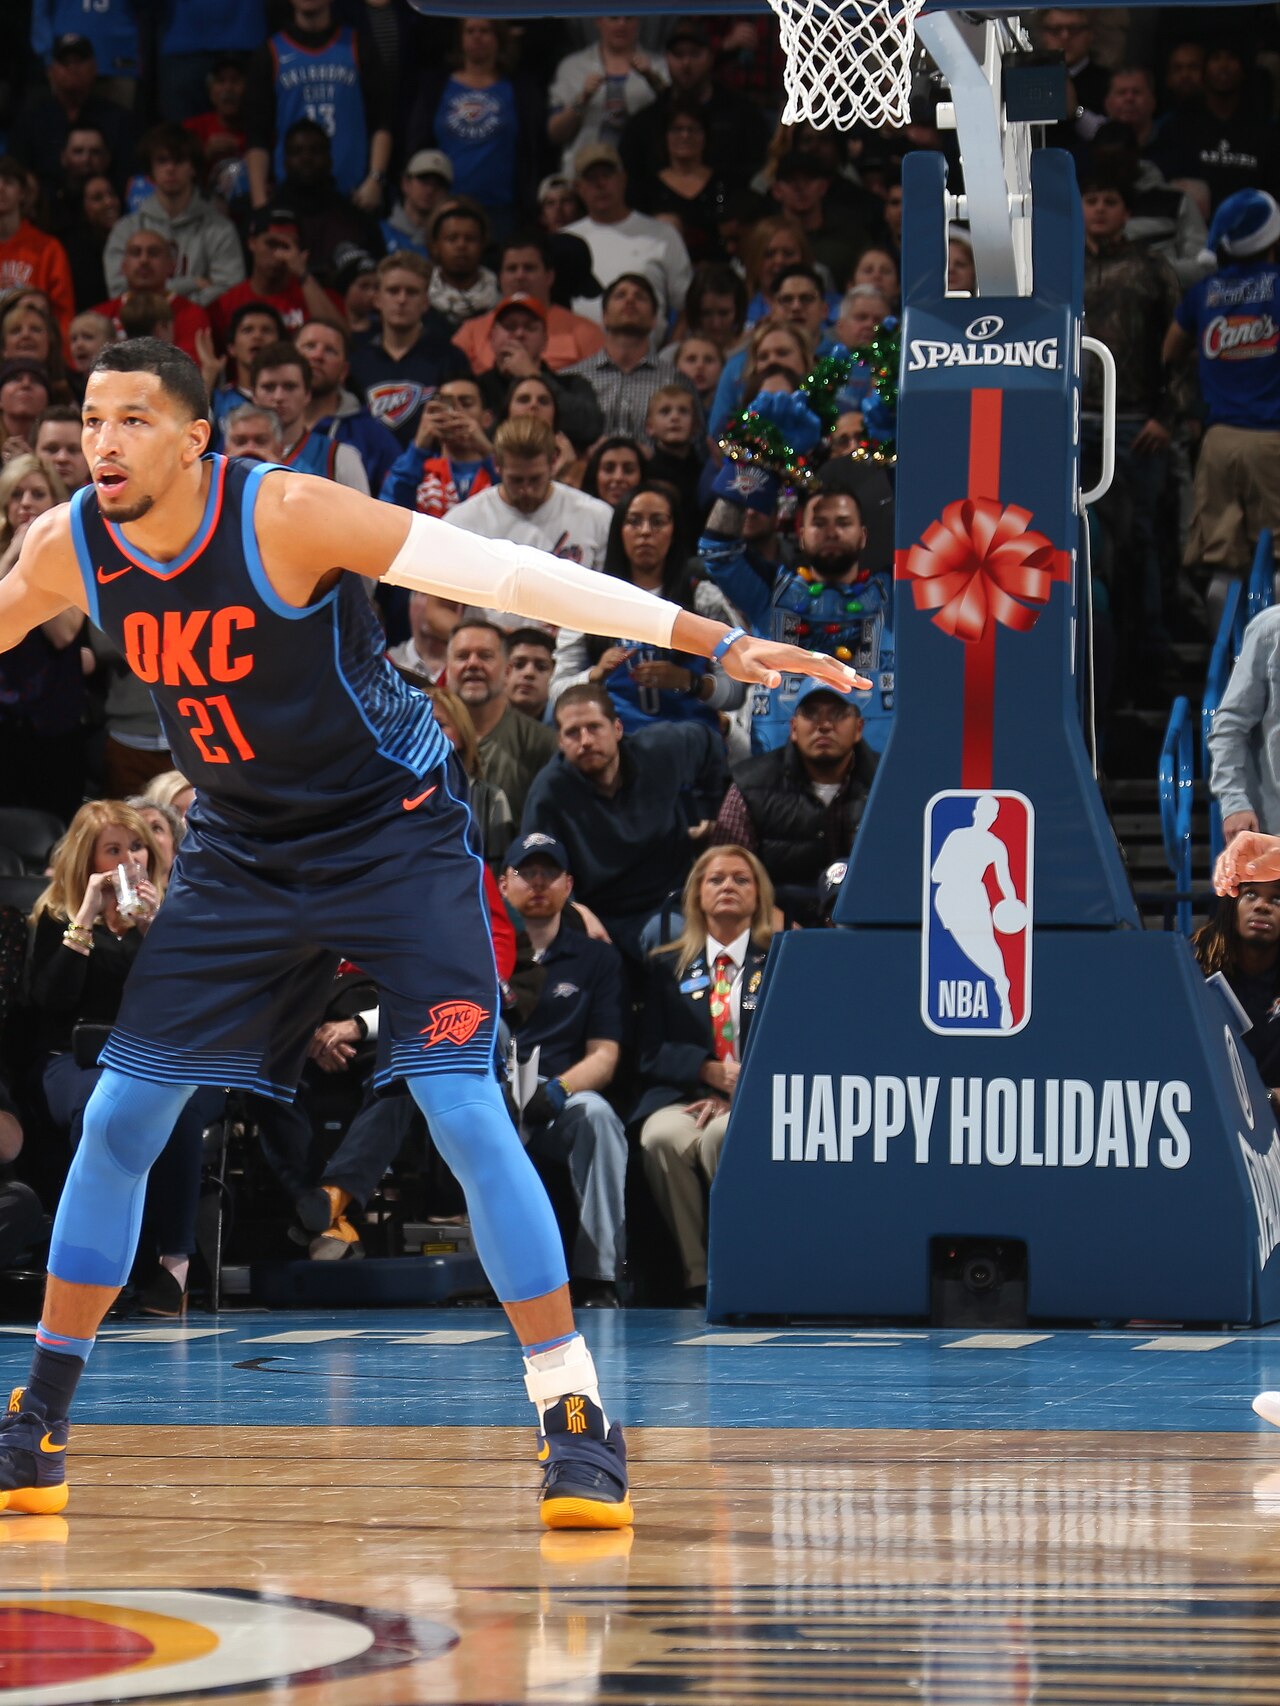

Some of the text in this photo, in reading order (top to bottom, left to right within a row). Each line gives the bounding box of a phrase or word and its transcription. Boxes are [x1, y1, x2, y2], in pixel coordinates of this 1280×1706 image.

[908, 337, 1058, 371] SPALDING
[1204, 313, 1278, 360] Cane's
[123, 605, 256, 686] OKC
[177, 694, 256, 764] 21
[938, 980, 989, 1018] NBA
[432, 1010, 471, 1038] OKC
[772, 1073, 1192, 1170] HAPPY HOLIDAYS
